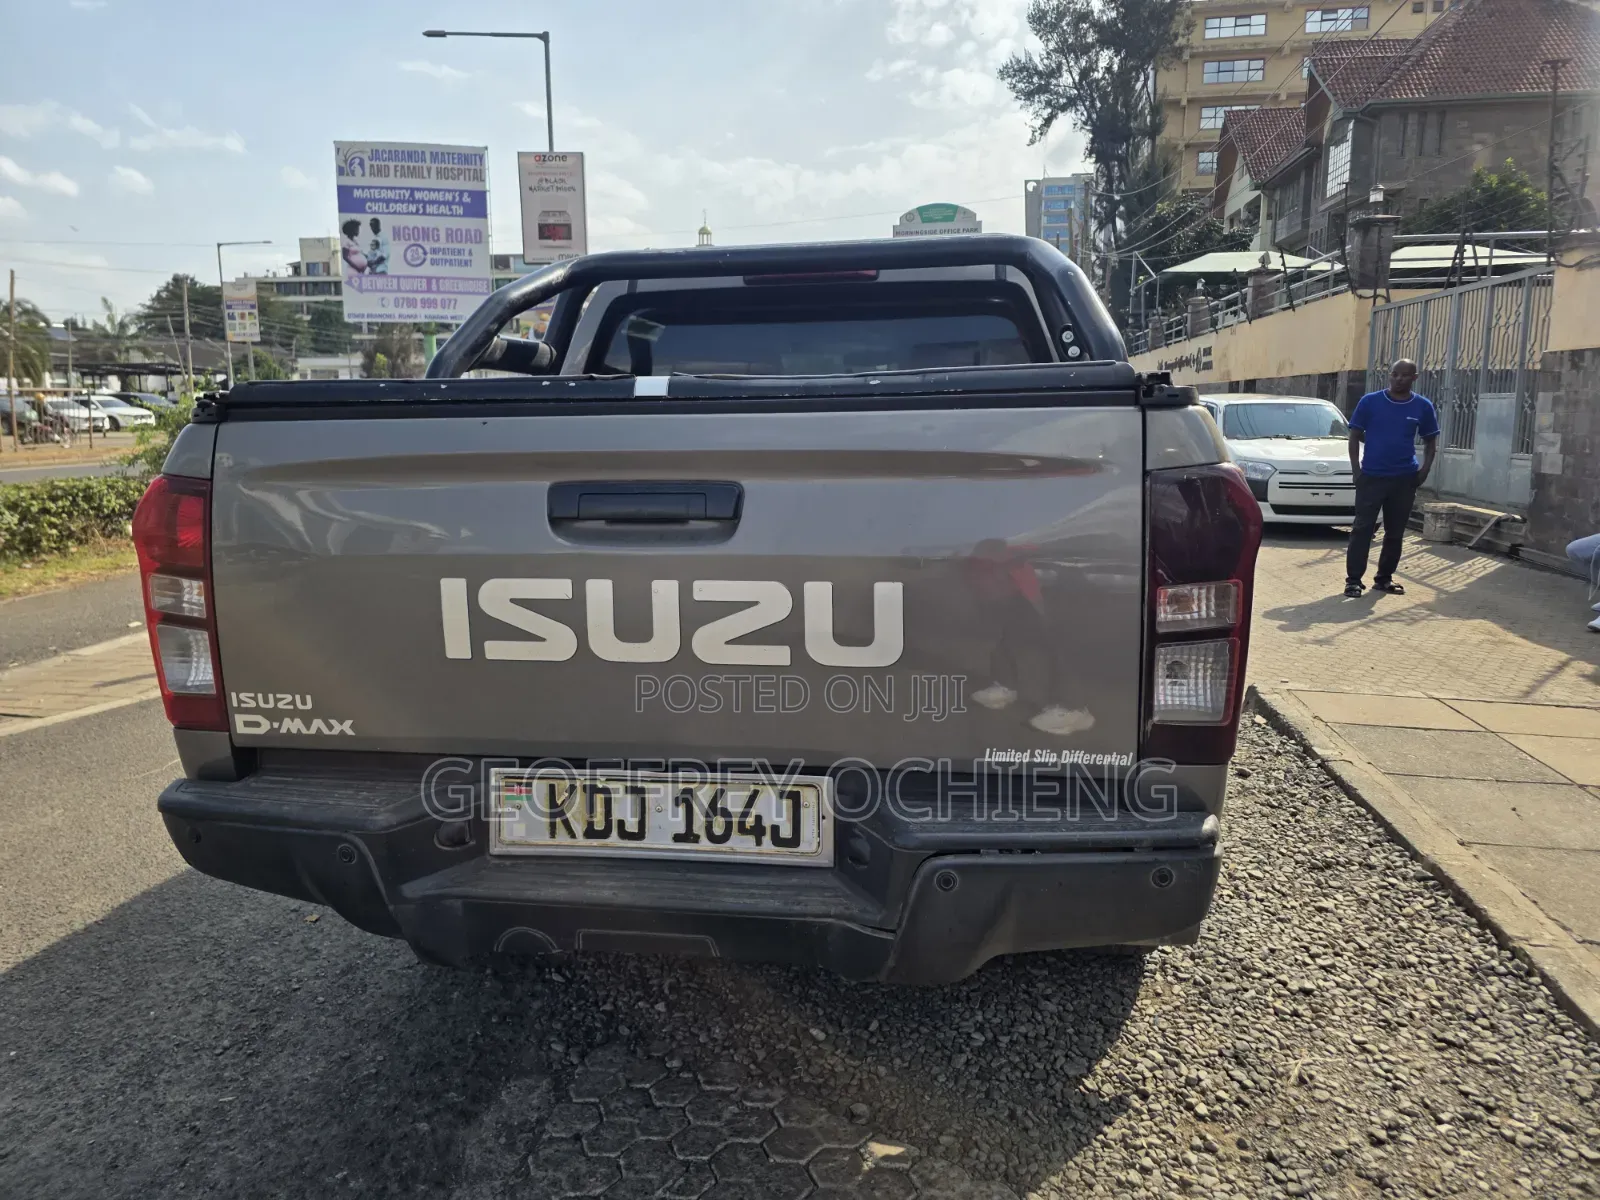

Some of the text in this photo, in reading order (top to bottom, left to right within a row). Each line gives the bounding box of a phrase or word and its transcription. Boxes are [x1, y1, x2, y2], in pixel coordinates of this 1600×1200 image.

[368, 149, 484, 166] JACARANDA MATERNITY
[534, 154, 567, 162] azone
[369, 164, 485, 182] AND FAMILY HOSPITAL
[414, 190, 460, 202] WOMEN'S
[462, 192, 471, 203] &
[365, 201, 463, 216] CHILDREN'S HEALTH
[392, 225, 483, 244] NGONG ROAD
[430, 246, 473, 257] INPATIENT &
[430, 257, 473, 267] OUTPATIENT
[362, 277, 488, 293] BETWEEN QUIVER & GREENHOUSE
[440, 298, 458, 310] 077
[440, 577, 905, 667] ISUZU
[230, 691, 313, 710] ISUZU
[984, 748, 1133, 766] Limited Slip Differential
[548, 782, 648, 842] KDJ
[672, 786, 801, 849] 164J
